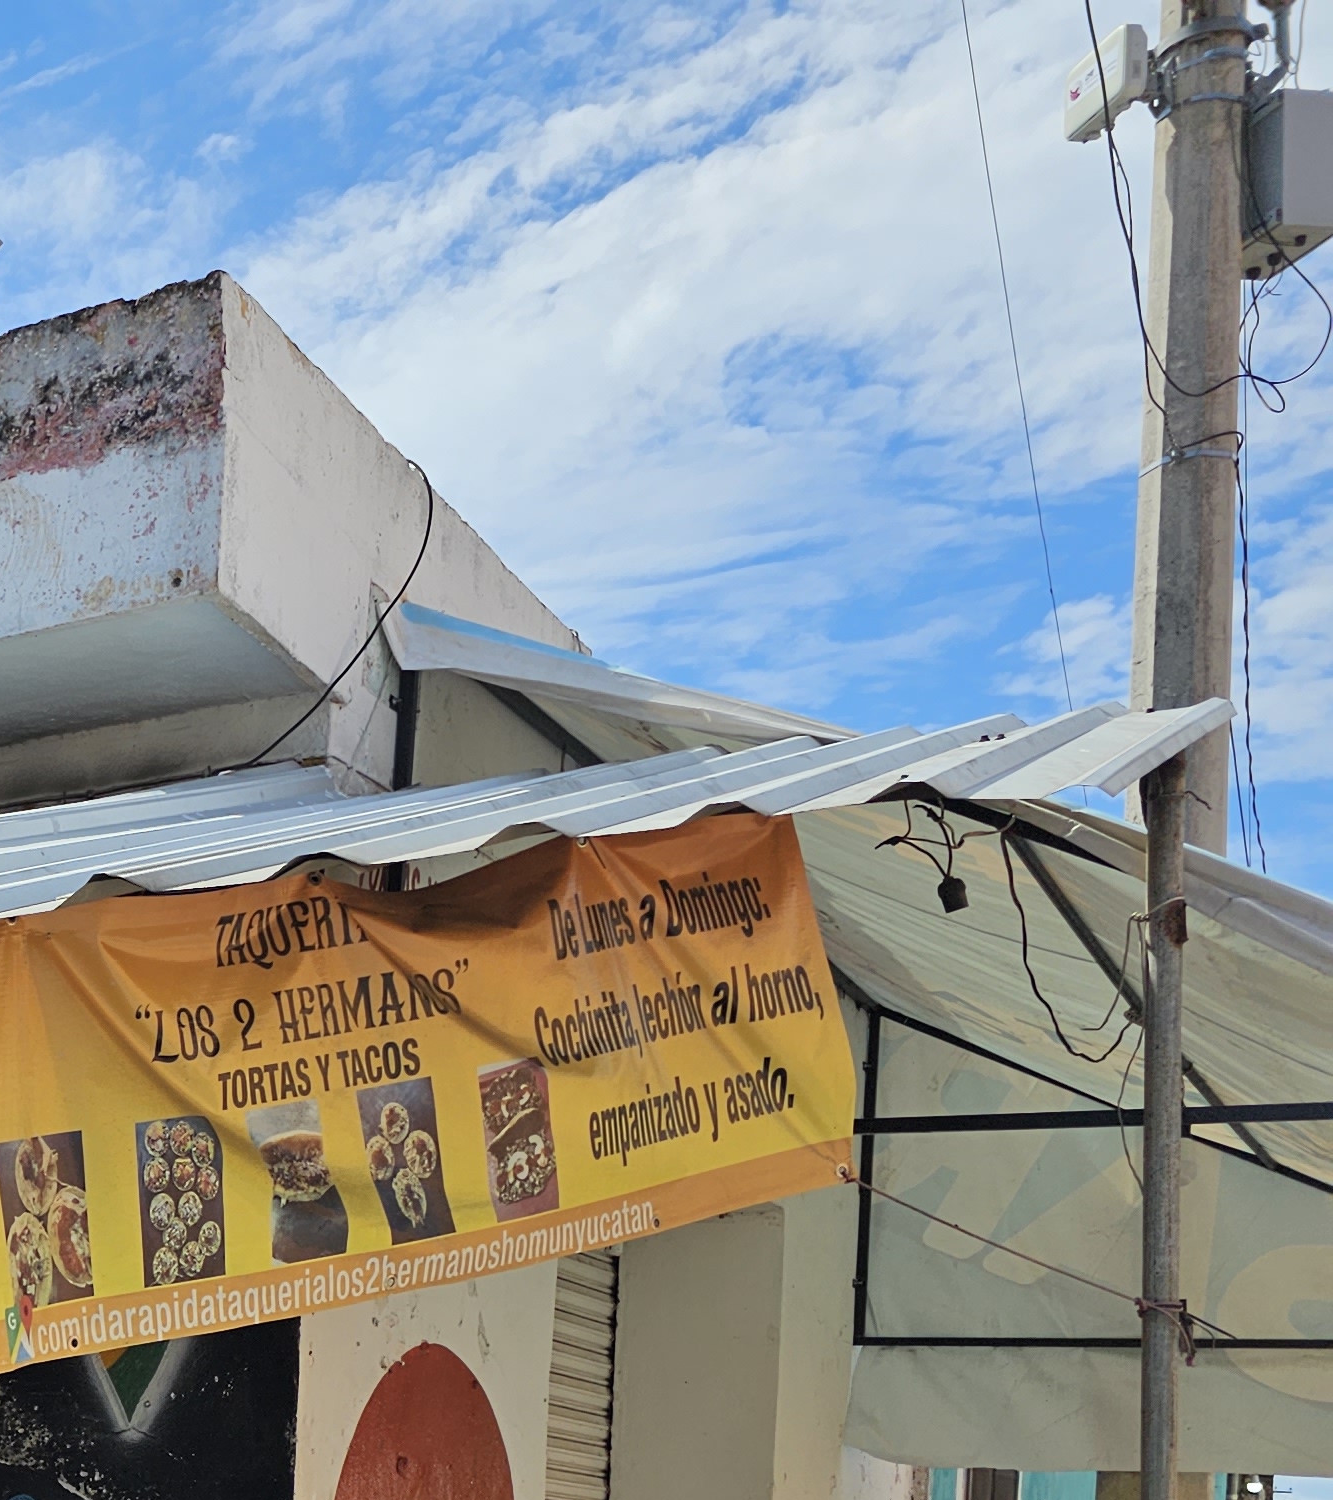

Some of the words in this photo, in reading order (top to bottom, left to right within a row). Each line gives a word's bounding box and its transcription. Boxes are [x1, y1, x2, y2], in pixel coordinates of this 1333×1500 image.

[547, 898, 579, 961] De
[575, 893, 635, 955] Lunes
[639, 894, 656, 941] a
[659, 871, 771, 938] Domingo:
[234, 998, 262, 1052] 2
[534, 991, 643, 1067] Cochinita,
[632, 971, 707, 1043] lechón
[710, 965, 739, 1027] al
[744, 963, 824, 1023] horno,
[217, 1057, 312, 1111] TORTAS
[315, 1054, 330, 1092] Y
[336, 1037, 421, 1088] TACOS
[589, 1076, 700, 1167] empanizado
[703, 1081, 720, 1142] y
[723, 1056, 795, 1124] asado.
[36, 1199, 654, 1356] comidarapidataquerialos2hermanoshomunyucatan
